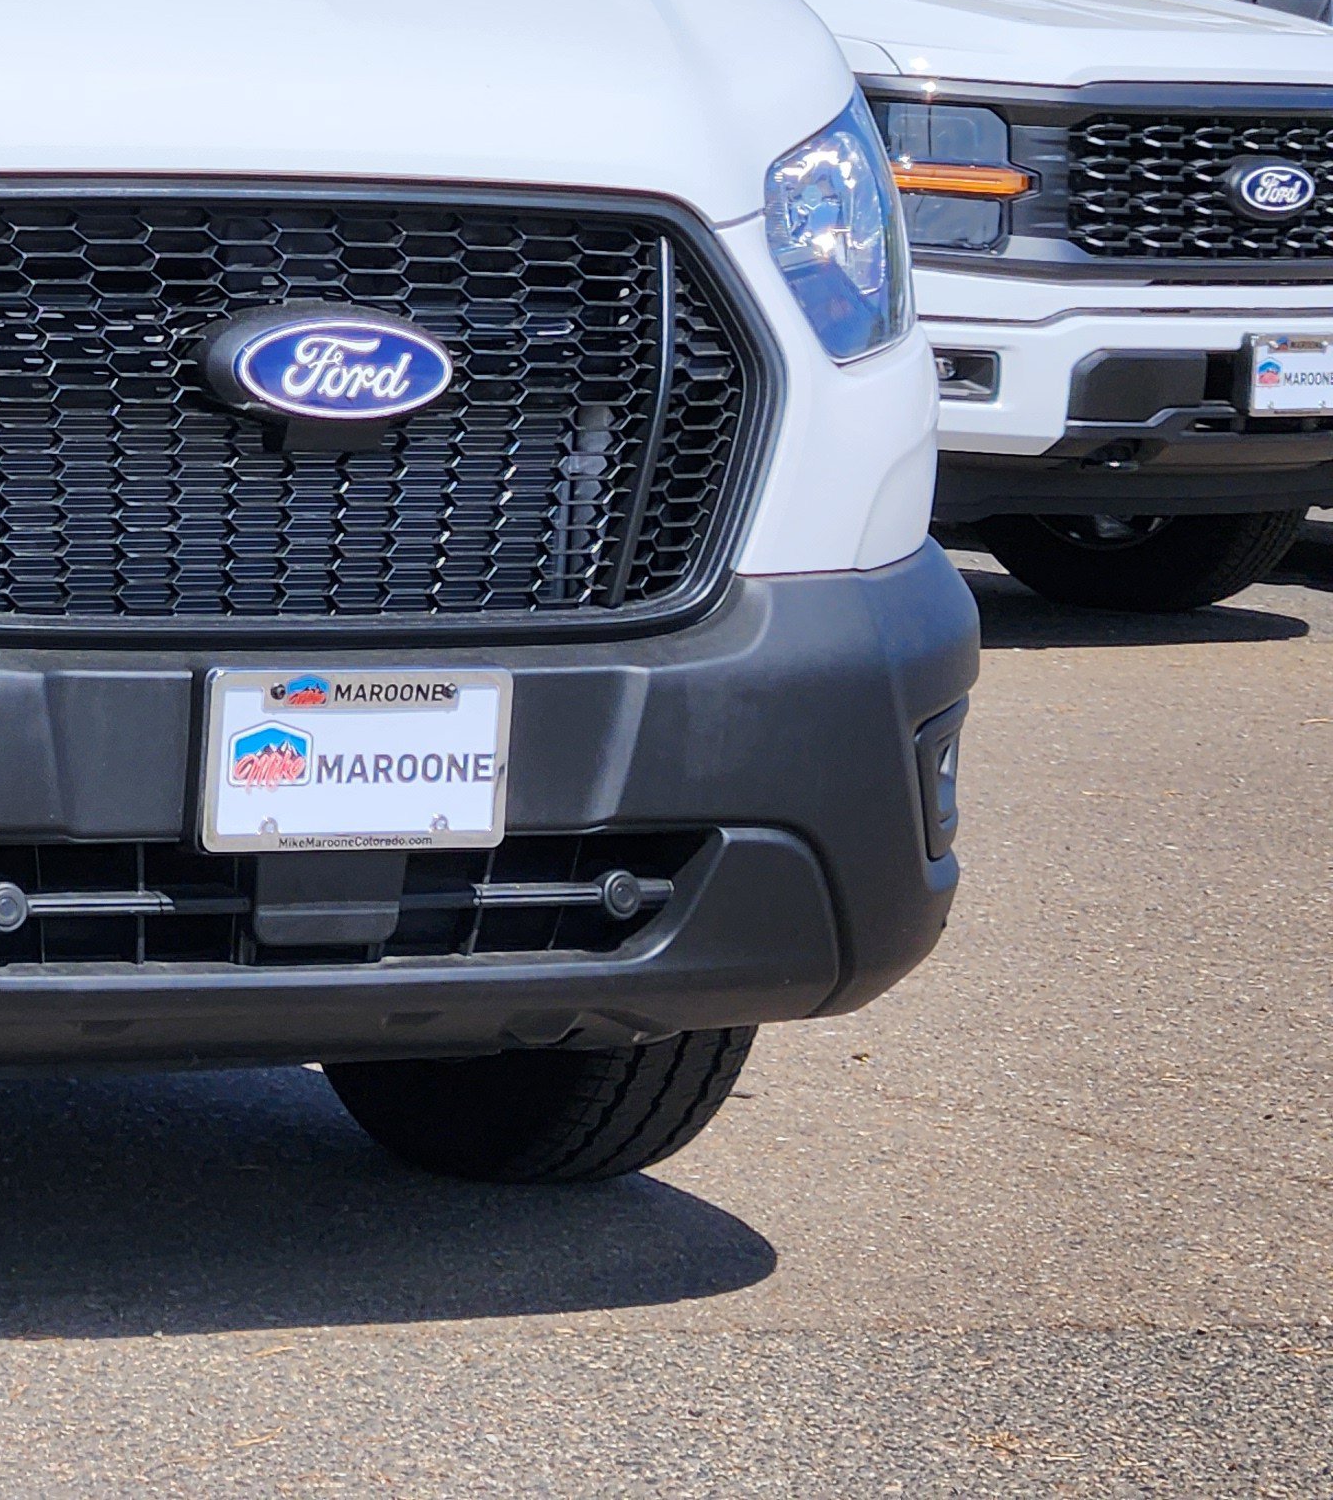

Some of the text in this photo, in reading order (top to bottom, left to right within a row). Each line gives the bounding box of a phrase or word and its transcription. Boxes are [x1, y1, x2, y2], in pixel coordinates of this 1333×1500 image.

[1254, 171, 1302, 203] Ford
[283, 334, 413, 399] Ford
[334, 683, 444, 702] MAROONE
[316, 752, 495, 784] MAROONE
